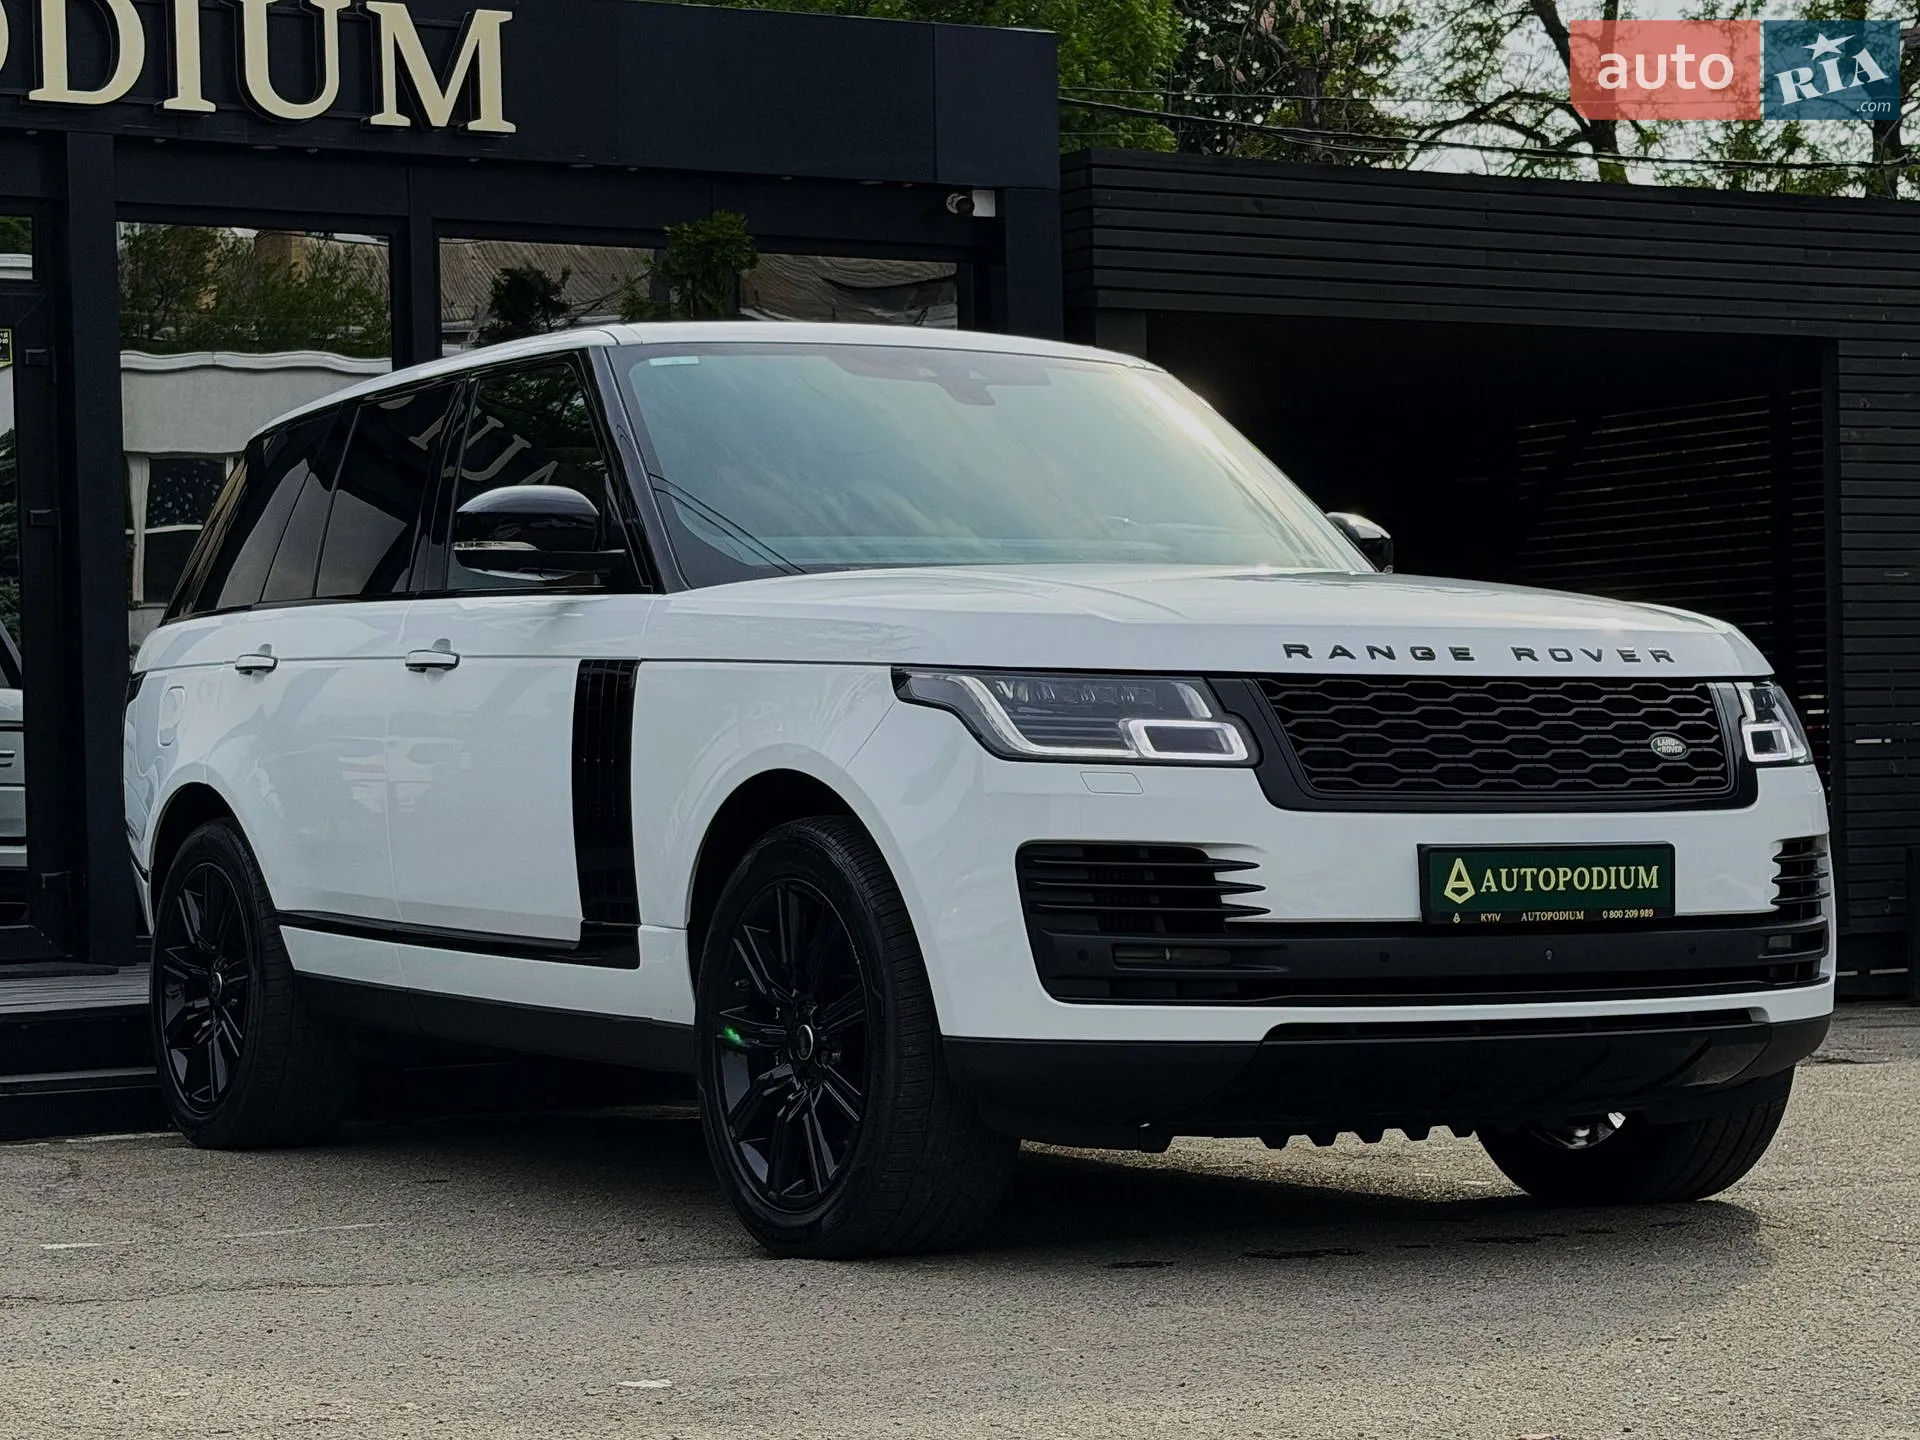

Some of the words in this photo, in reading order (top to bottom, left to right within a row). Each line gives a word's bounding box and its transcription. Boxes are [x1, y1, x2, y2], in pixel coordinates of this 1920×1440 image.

[0, 0, 517, 133] DIUM
[1282, 643, 1476, 663] RANGE
[1510, 646, 1676, 664] ROVER
[1479, 864, 1660, 893] AUTOPODIUM
[1480, 912, 1501, 923] KYIV
[1520, 910, 1584, 922] AUTOPODIUM
